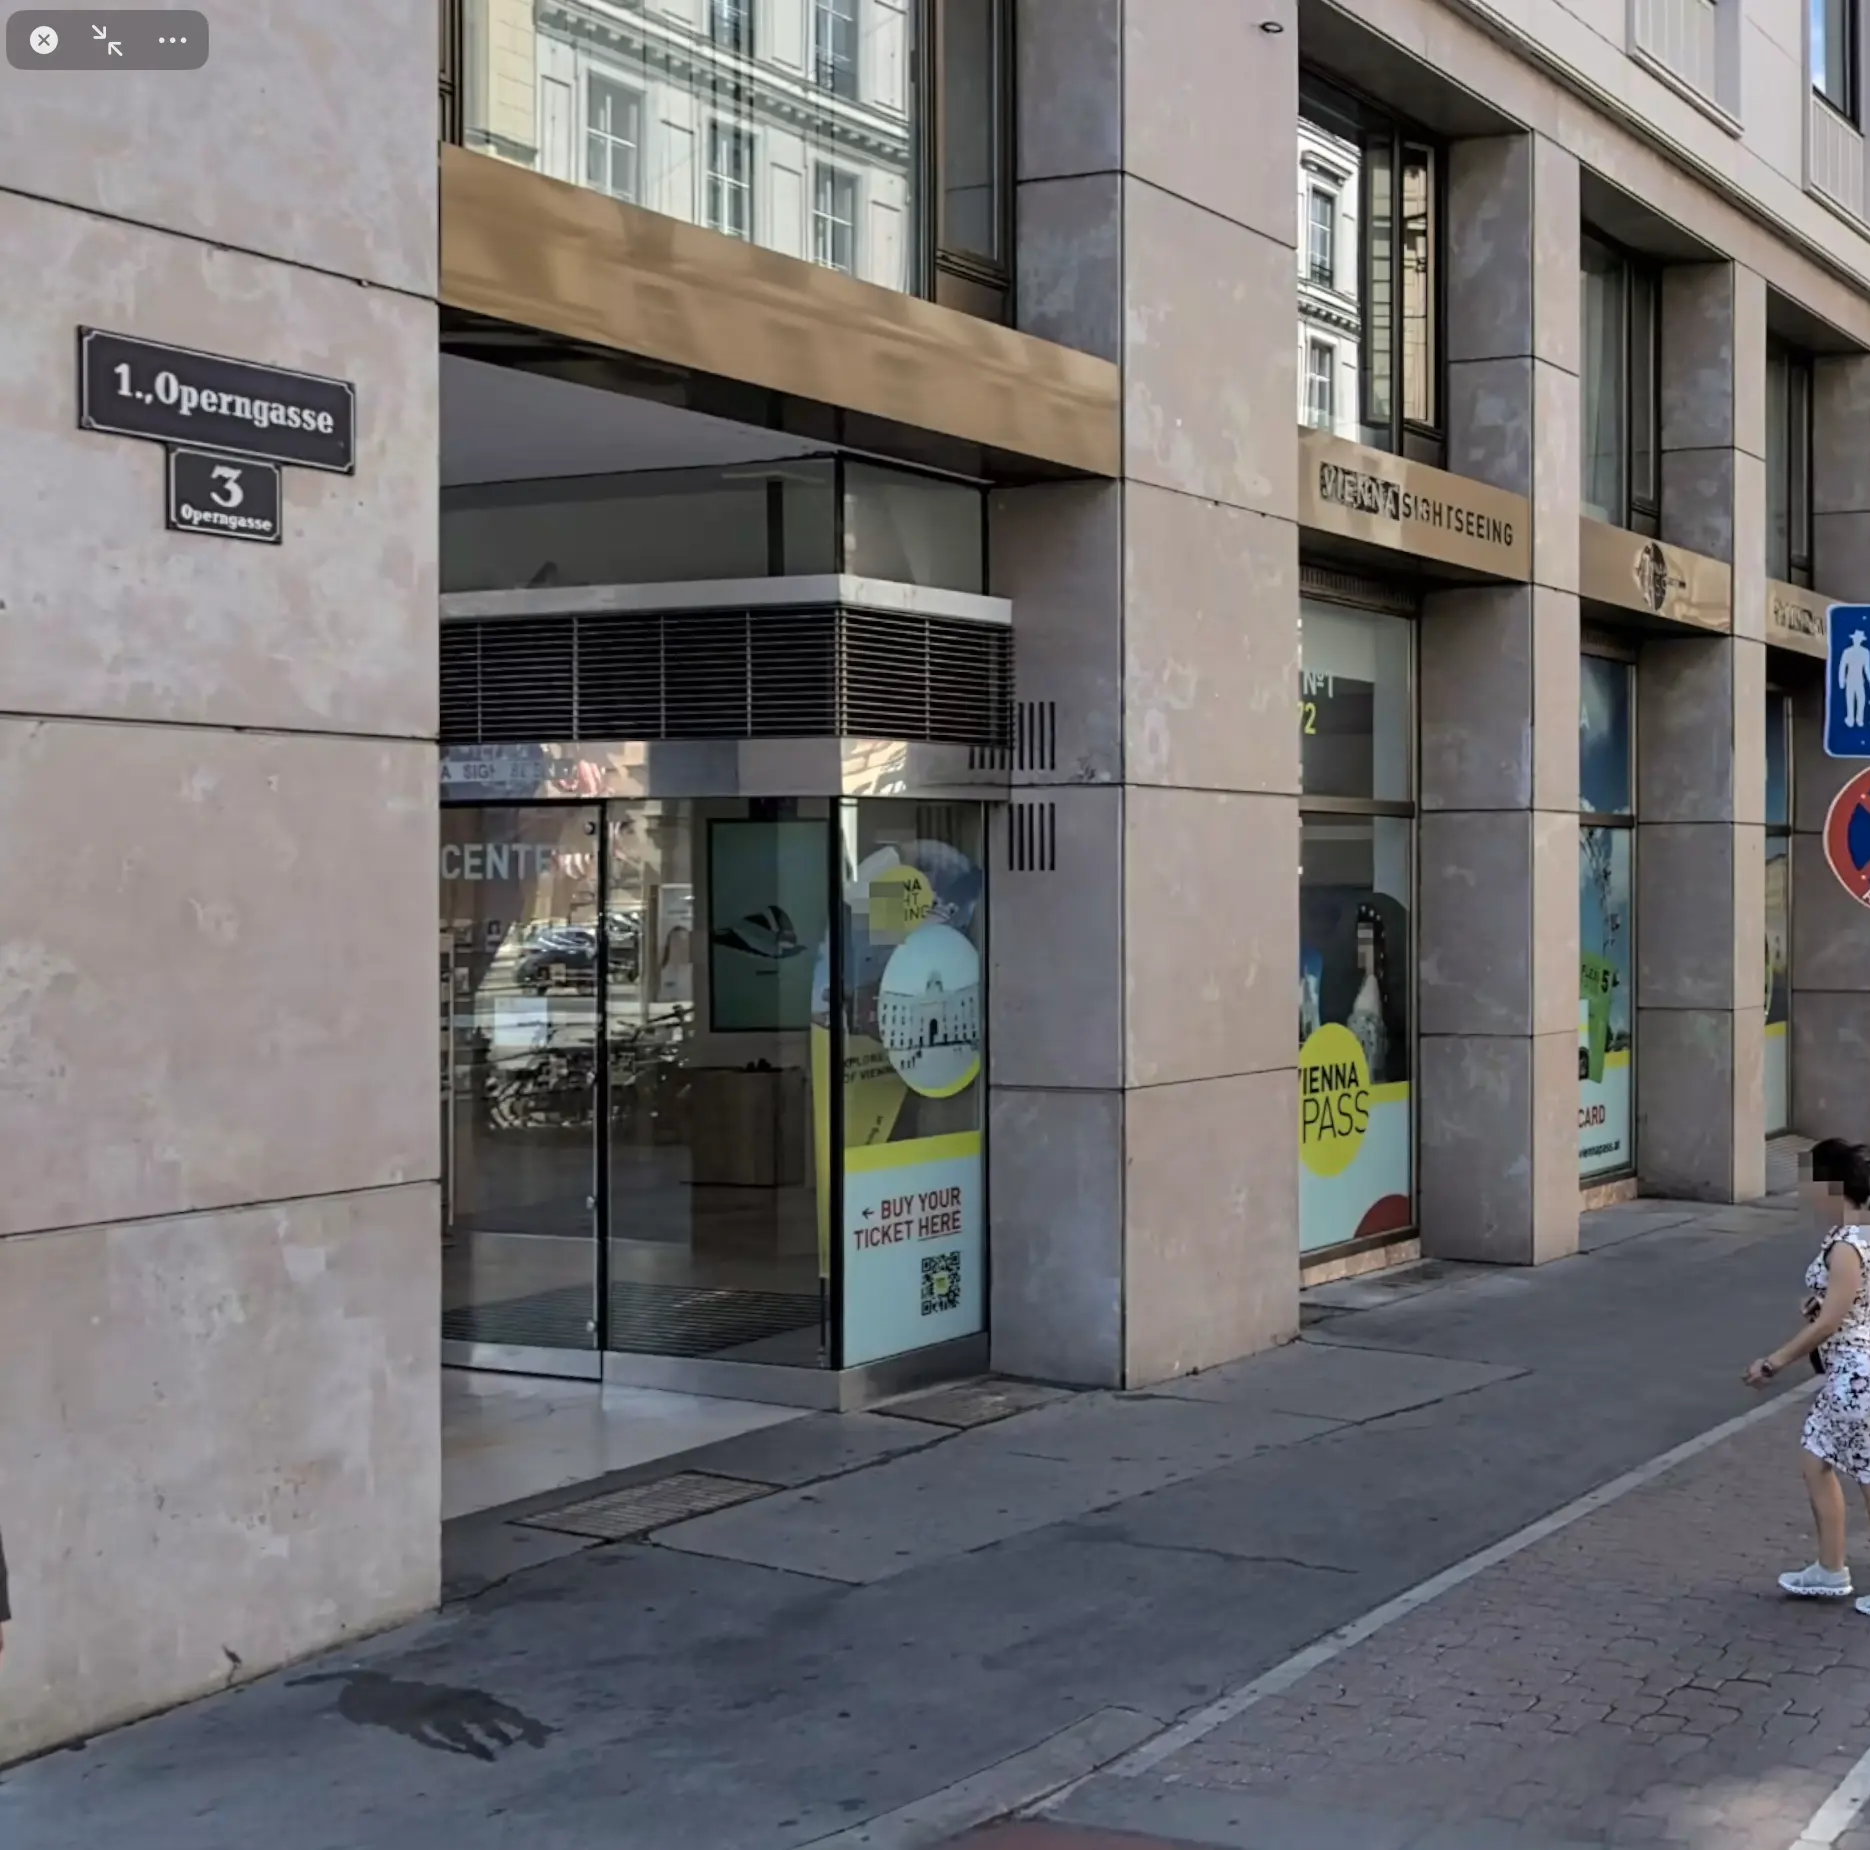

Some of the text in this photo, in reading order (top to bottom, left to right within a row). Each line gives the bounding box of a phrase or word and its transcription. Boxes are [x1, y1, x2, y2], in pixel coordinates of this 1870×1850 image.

[209, 465, 244, 508] 3
[180, 503, 273, 532] Operngasse
[1402, 492, 1514, 547] SIGHTSEEING
[441, 843, 553, 880] CENTE
[1302, 1061, 1359, 1096] IENNA
[1302, 1090, 1369, 1144] PASS
[881, 1186, 961, 1220] BUY YOUR
[854, 1211, 961, 1251] TICKET HERE
